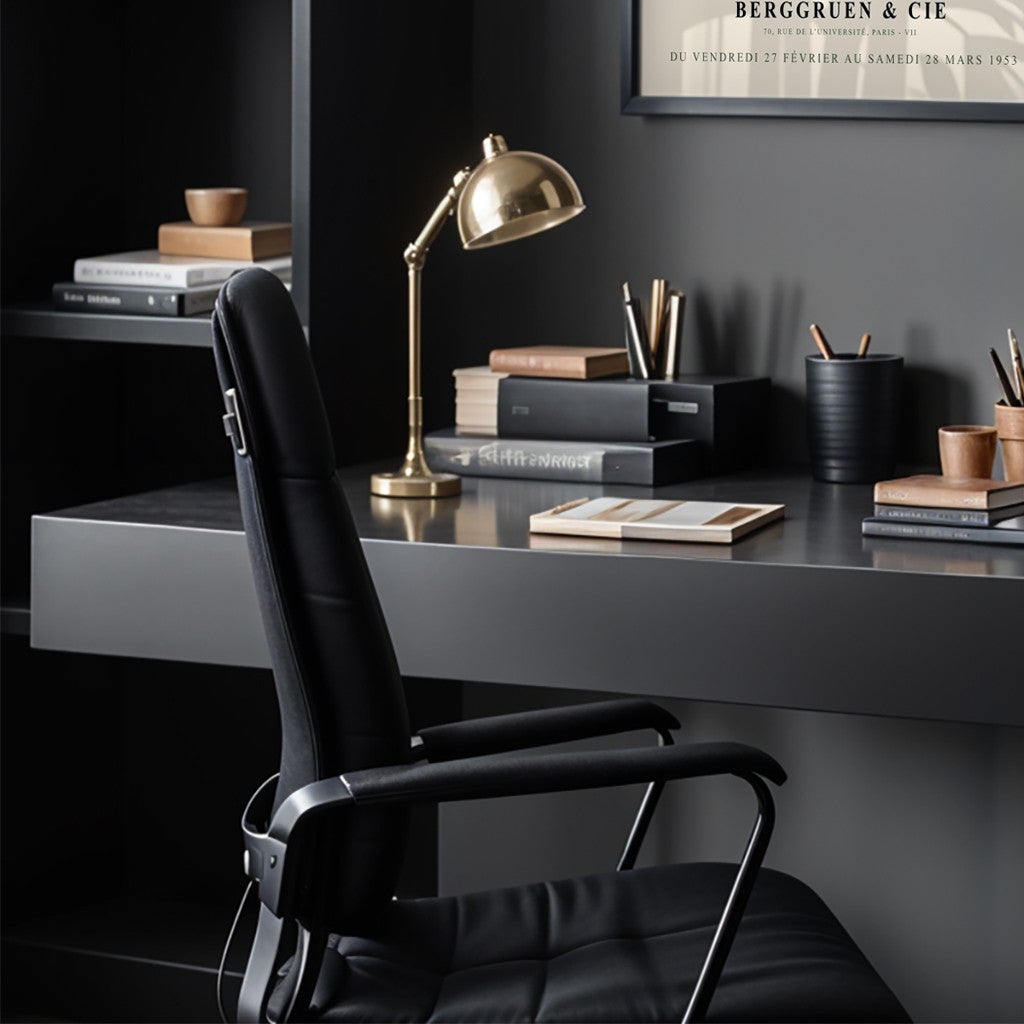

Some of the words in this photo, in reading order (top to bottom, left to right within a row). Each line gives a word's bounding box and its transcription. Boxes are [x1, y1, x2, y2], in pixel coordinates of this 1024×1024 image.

[735, 1, 871, 19] BERGGRUEN
[882, 1, 897, 19] &
[908, 1, 946, 19] CIE
[764, 28, 775, 36] 70,
[777, 28, 794, 36] RUE
[796, 28, 807, 36] DE
[670, 51, 687, 62] DU
[693, 51, 758, 63] VENDREDI
[764, 53, 777, 62] 27
[783, 50, 839, 63] FÉVRIER
[844, 54, 862, 64] AU
[868, 54, 919, 64] SAMEDI
[925, 55, 939, 64] 28
[945, 55, 982, 65] MARS
[989, 55, 1018, 66] 1953
